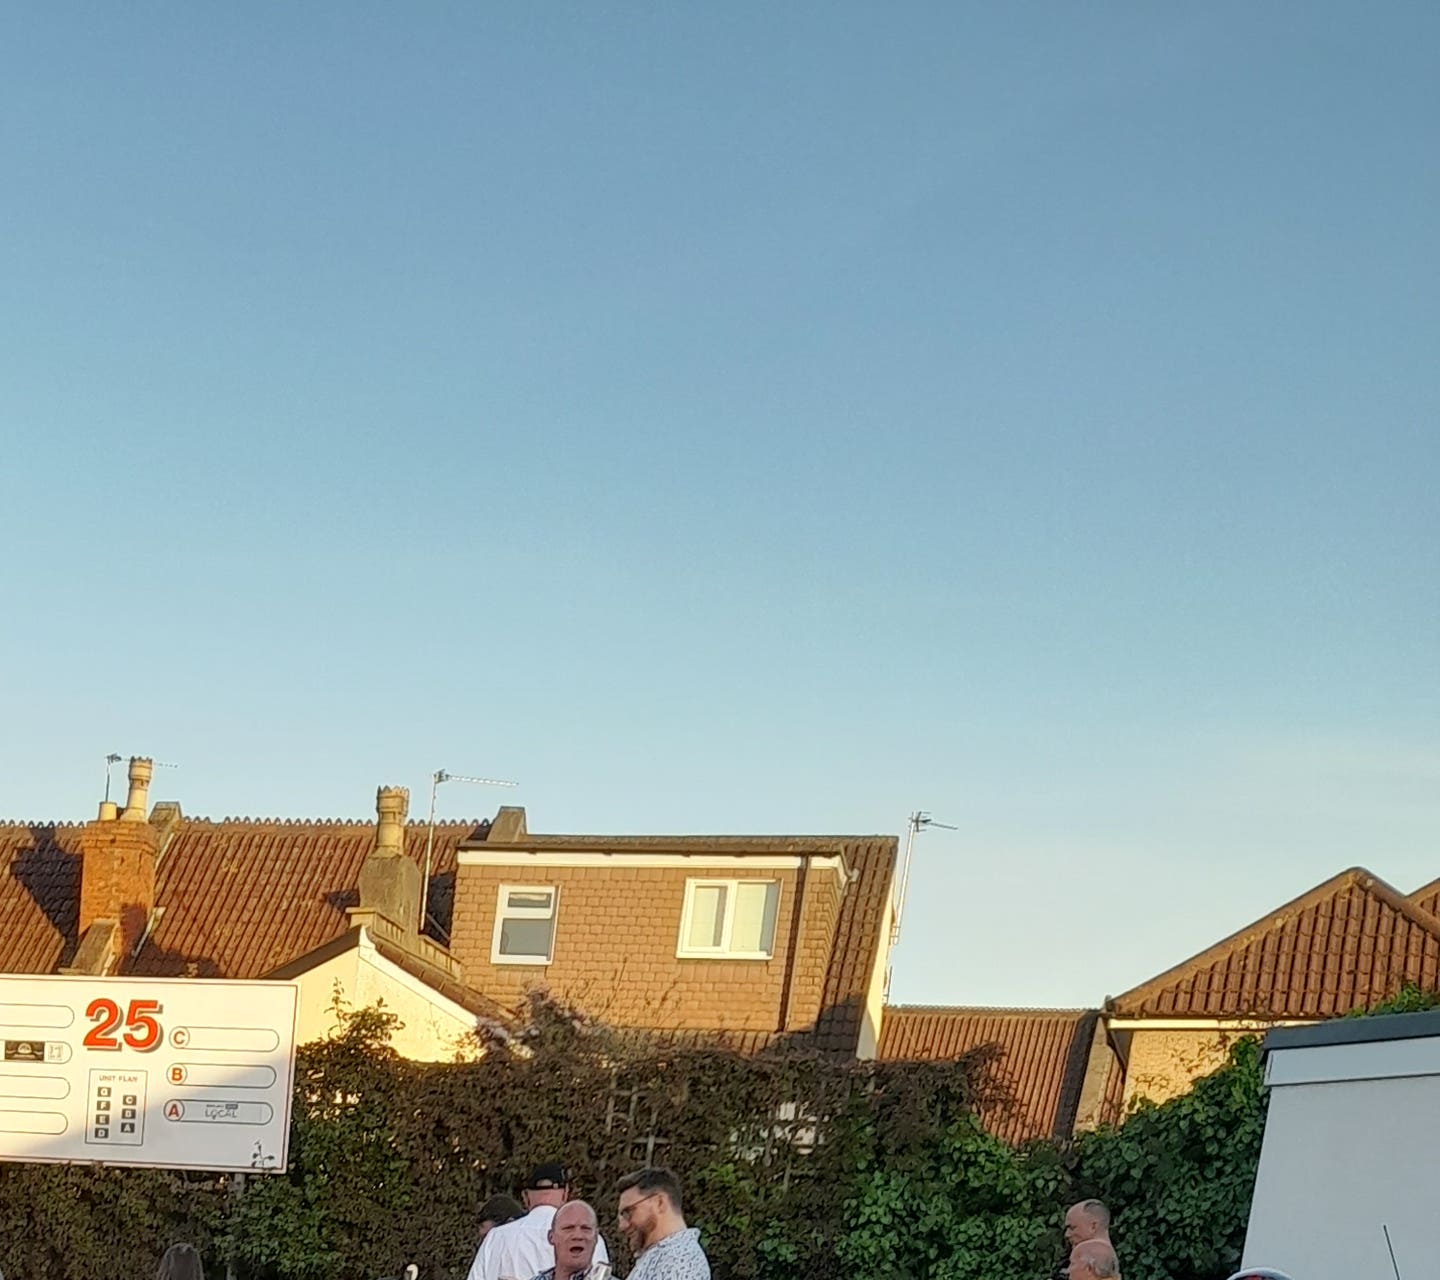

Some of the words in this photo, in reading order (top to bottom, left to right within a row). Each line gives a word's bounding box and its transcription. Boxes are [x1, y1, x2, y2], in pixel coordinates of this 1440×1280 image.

[82, 998, 162, 1052] 25
[173, 1031, 185, 1045] C
[171, 1068, 183, 1081] B
[168, 1104, 180, 1117] A
